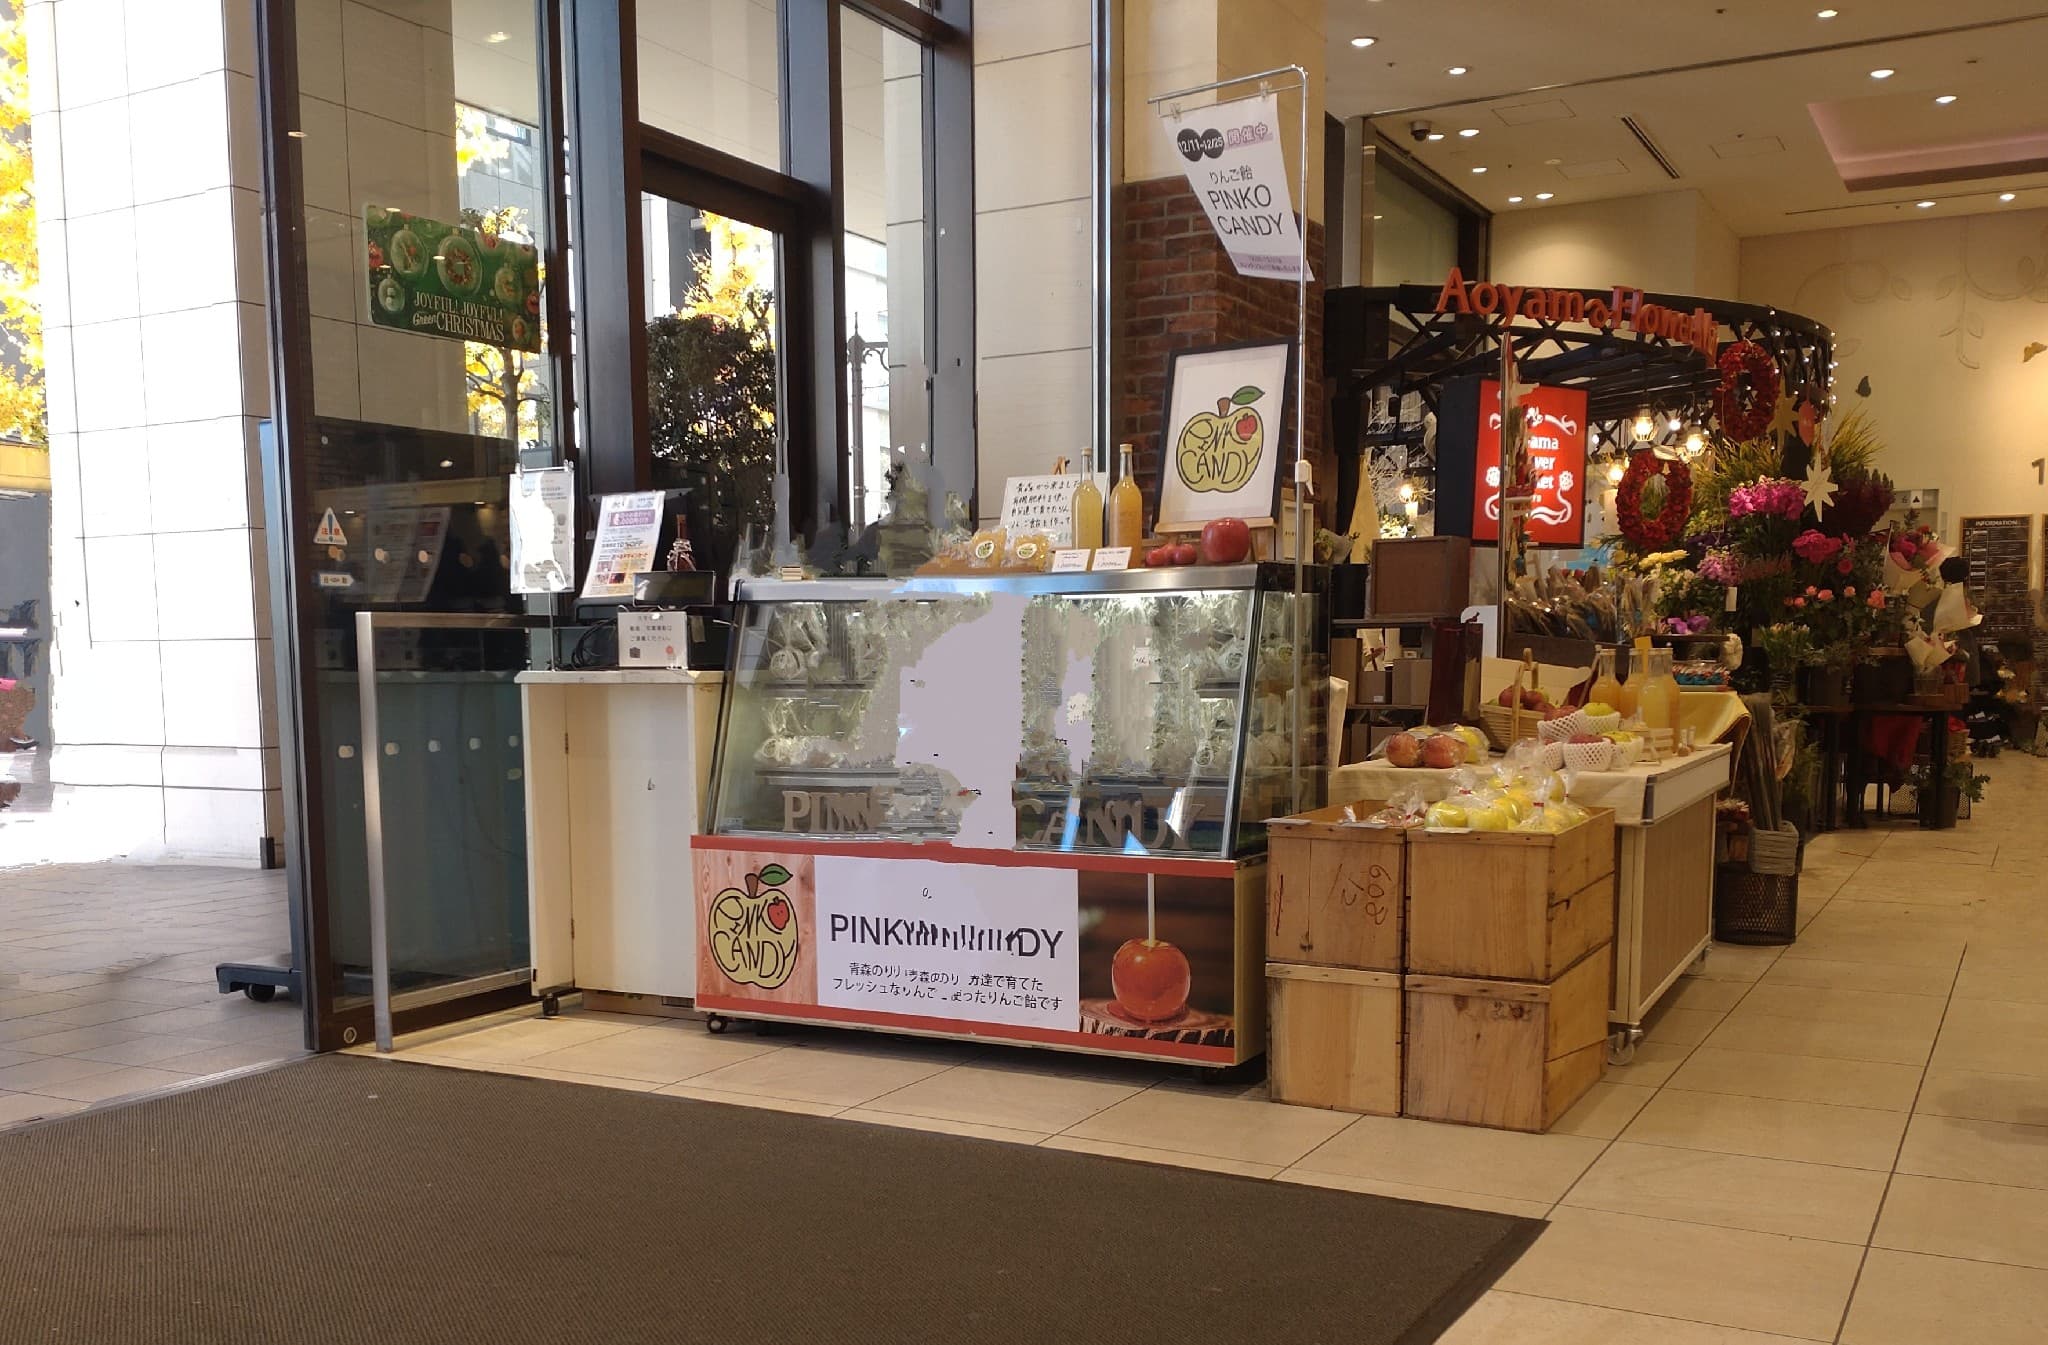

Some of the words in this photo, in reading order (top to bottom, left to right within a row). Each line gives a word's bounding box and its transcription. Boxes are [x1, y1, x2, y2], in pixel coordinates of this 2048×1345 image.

[1226, 121, 1269, 146] 開催中
[1209, 165, 1254, 184] りんご飴
[1207, 184, 1272, 210] PINKO
[1217, 212, 1284, 237] CANDY
[414, 291, 458, 314] JOYFUL!
[461, 301, 504, 323] JOYFUL!
[1435, 268, 1608, 328] Aoyama
[436, 311, 505, 342] CHRISTMAS
[1529, 436, 1560, 450] ama
[1179, 448, 1260, 485] CANDY
[2031, 457, 2046, 486] 1
[713, 930, 796, 980] CANDY
